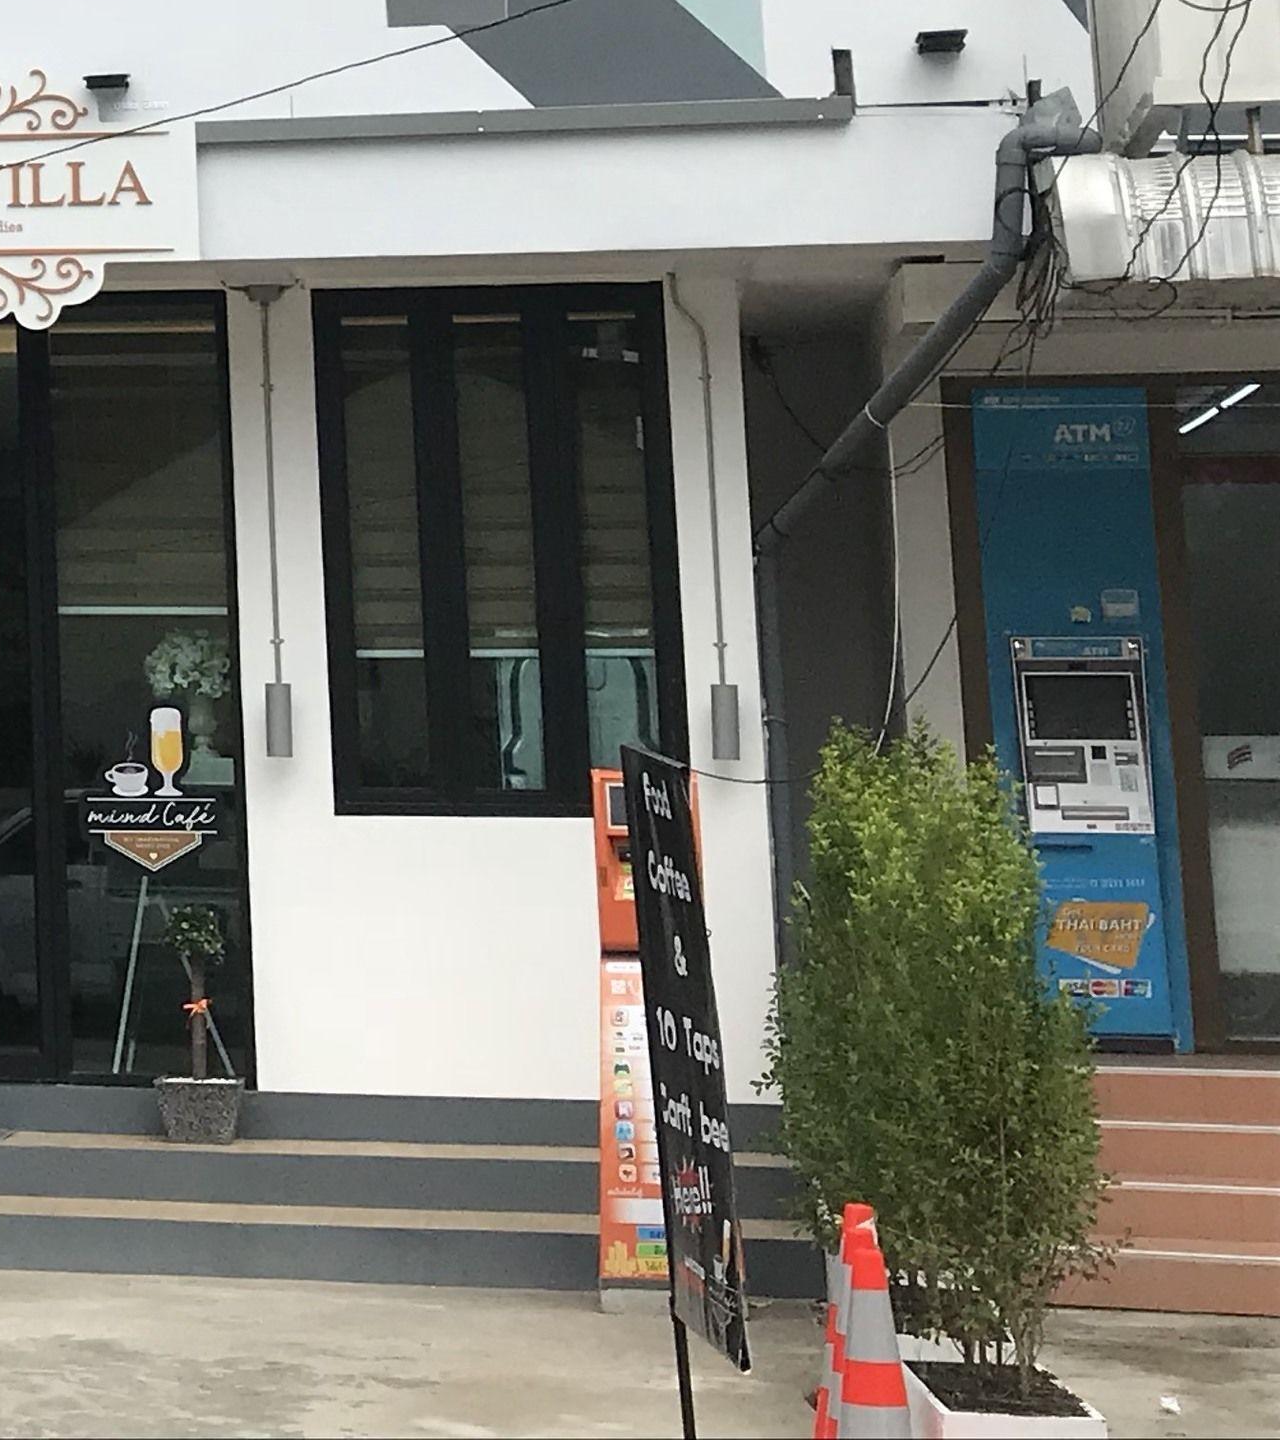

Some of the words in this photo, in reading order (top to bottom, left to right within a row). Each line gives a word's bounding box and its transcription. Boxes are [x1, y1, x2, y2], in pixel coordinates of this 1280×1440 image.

[1053, 423, 1111, 443] ATM
[643, 771, 672, 820] Food
[87, 803, 159, 824] mind
[162, 801, 216, 831] Café
[648, 849, 692, 902] Coffee
[1056, 919, 1094, 931] THAI
[1098, 919, 1142, 931] BAHT
[656, 1006, 677, 1051] 10
[682, 1016, 720, 1075] Taps
